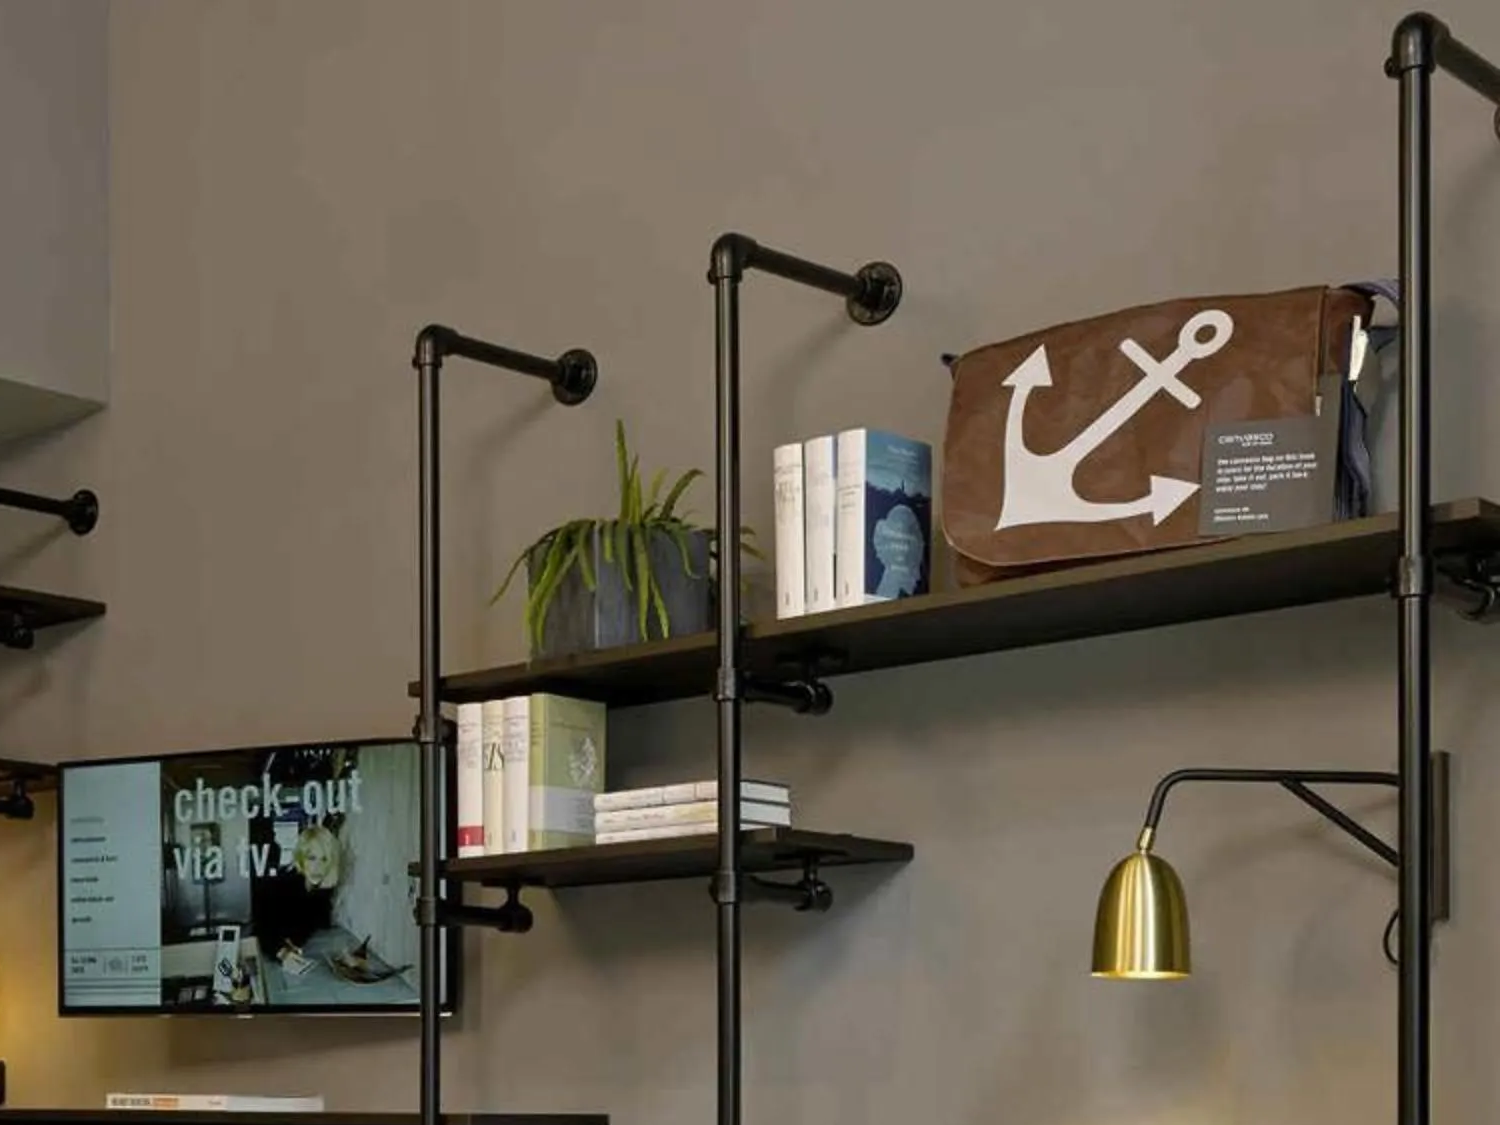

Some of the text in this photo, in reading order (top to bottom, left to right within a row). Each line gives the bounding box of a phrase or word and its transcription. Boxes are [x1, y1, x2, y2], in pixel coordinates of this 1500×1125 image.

[174, 769, 363, 824] check-out
[173, 839, 278, 881] via tv.
